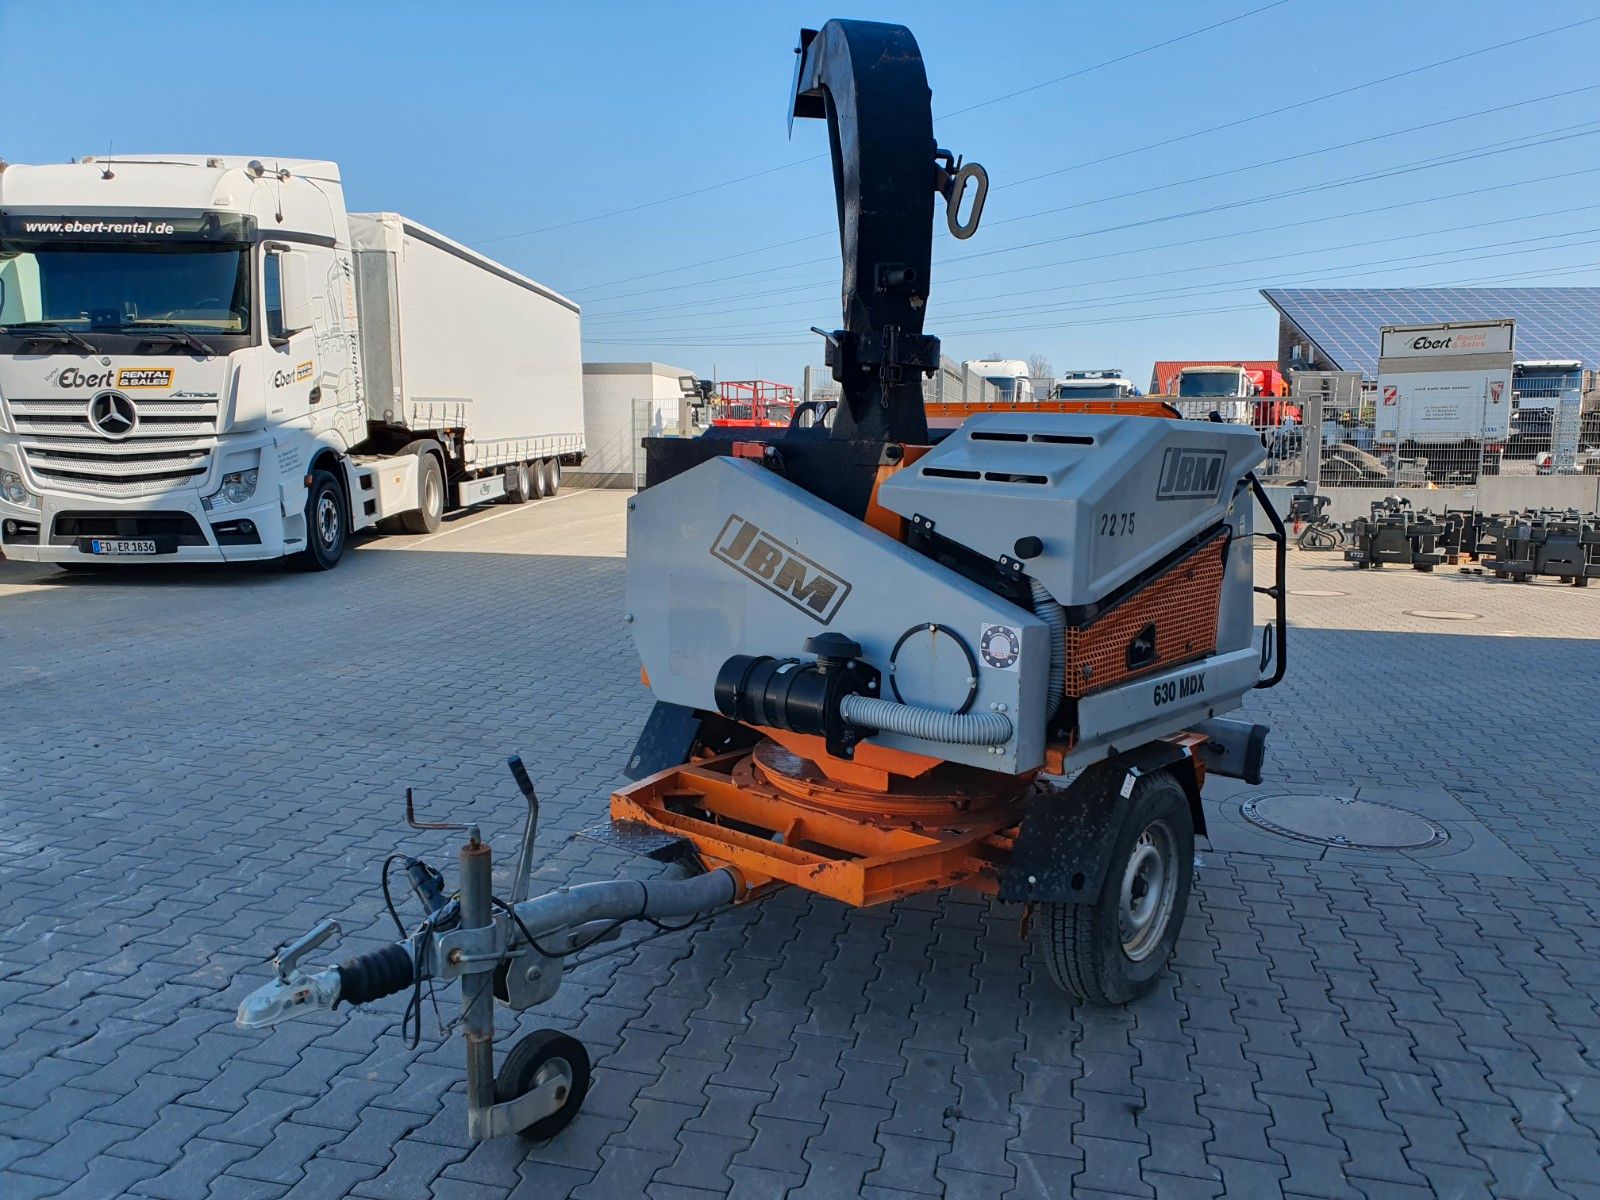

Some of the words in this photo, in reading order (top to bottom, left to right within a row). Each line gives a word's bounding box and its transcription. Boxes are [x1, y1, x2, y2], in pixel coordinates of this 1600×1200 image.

[26, 220, 174, 235] www.ebert-rental.de
[1413, 336, 1452, 350] Ebert
[59, 367, 114, 389] Ebert
[121, 371, 170, 379] RENTAL
[131, 378, 169, 386] SALES
[274, 369, 295, 388] Ebert
[1160, 447, 1222, 493] JBM
[100, 542, 112, 551] FD
[118, 542, 130, 551] ER
[132, 541, 155, 551] 1836
[719, 520, 839, 614] JBM
[1153, 681, 1176, 706] 630
[1179, 672, 1206, 698] MDX
